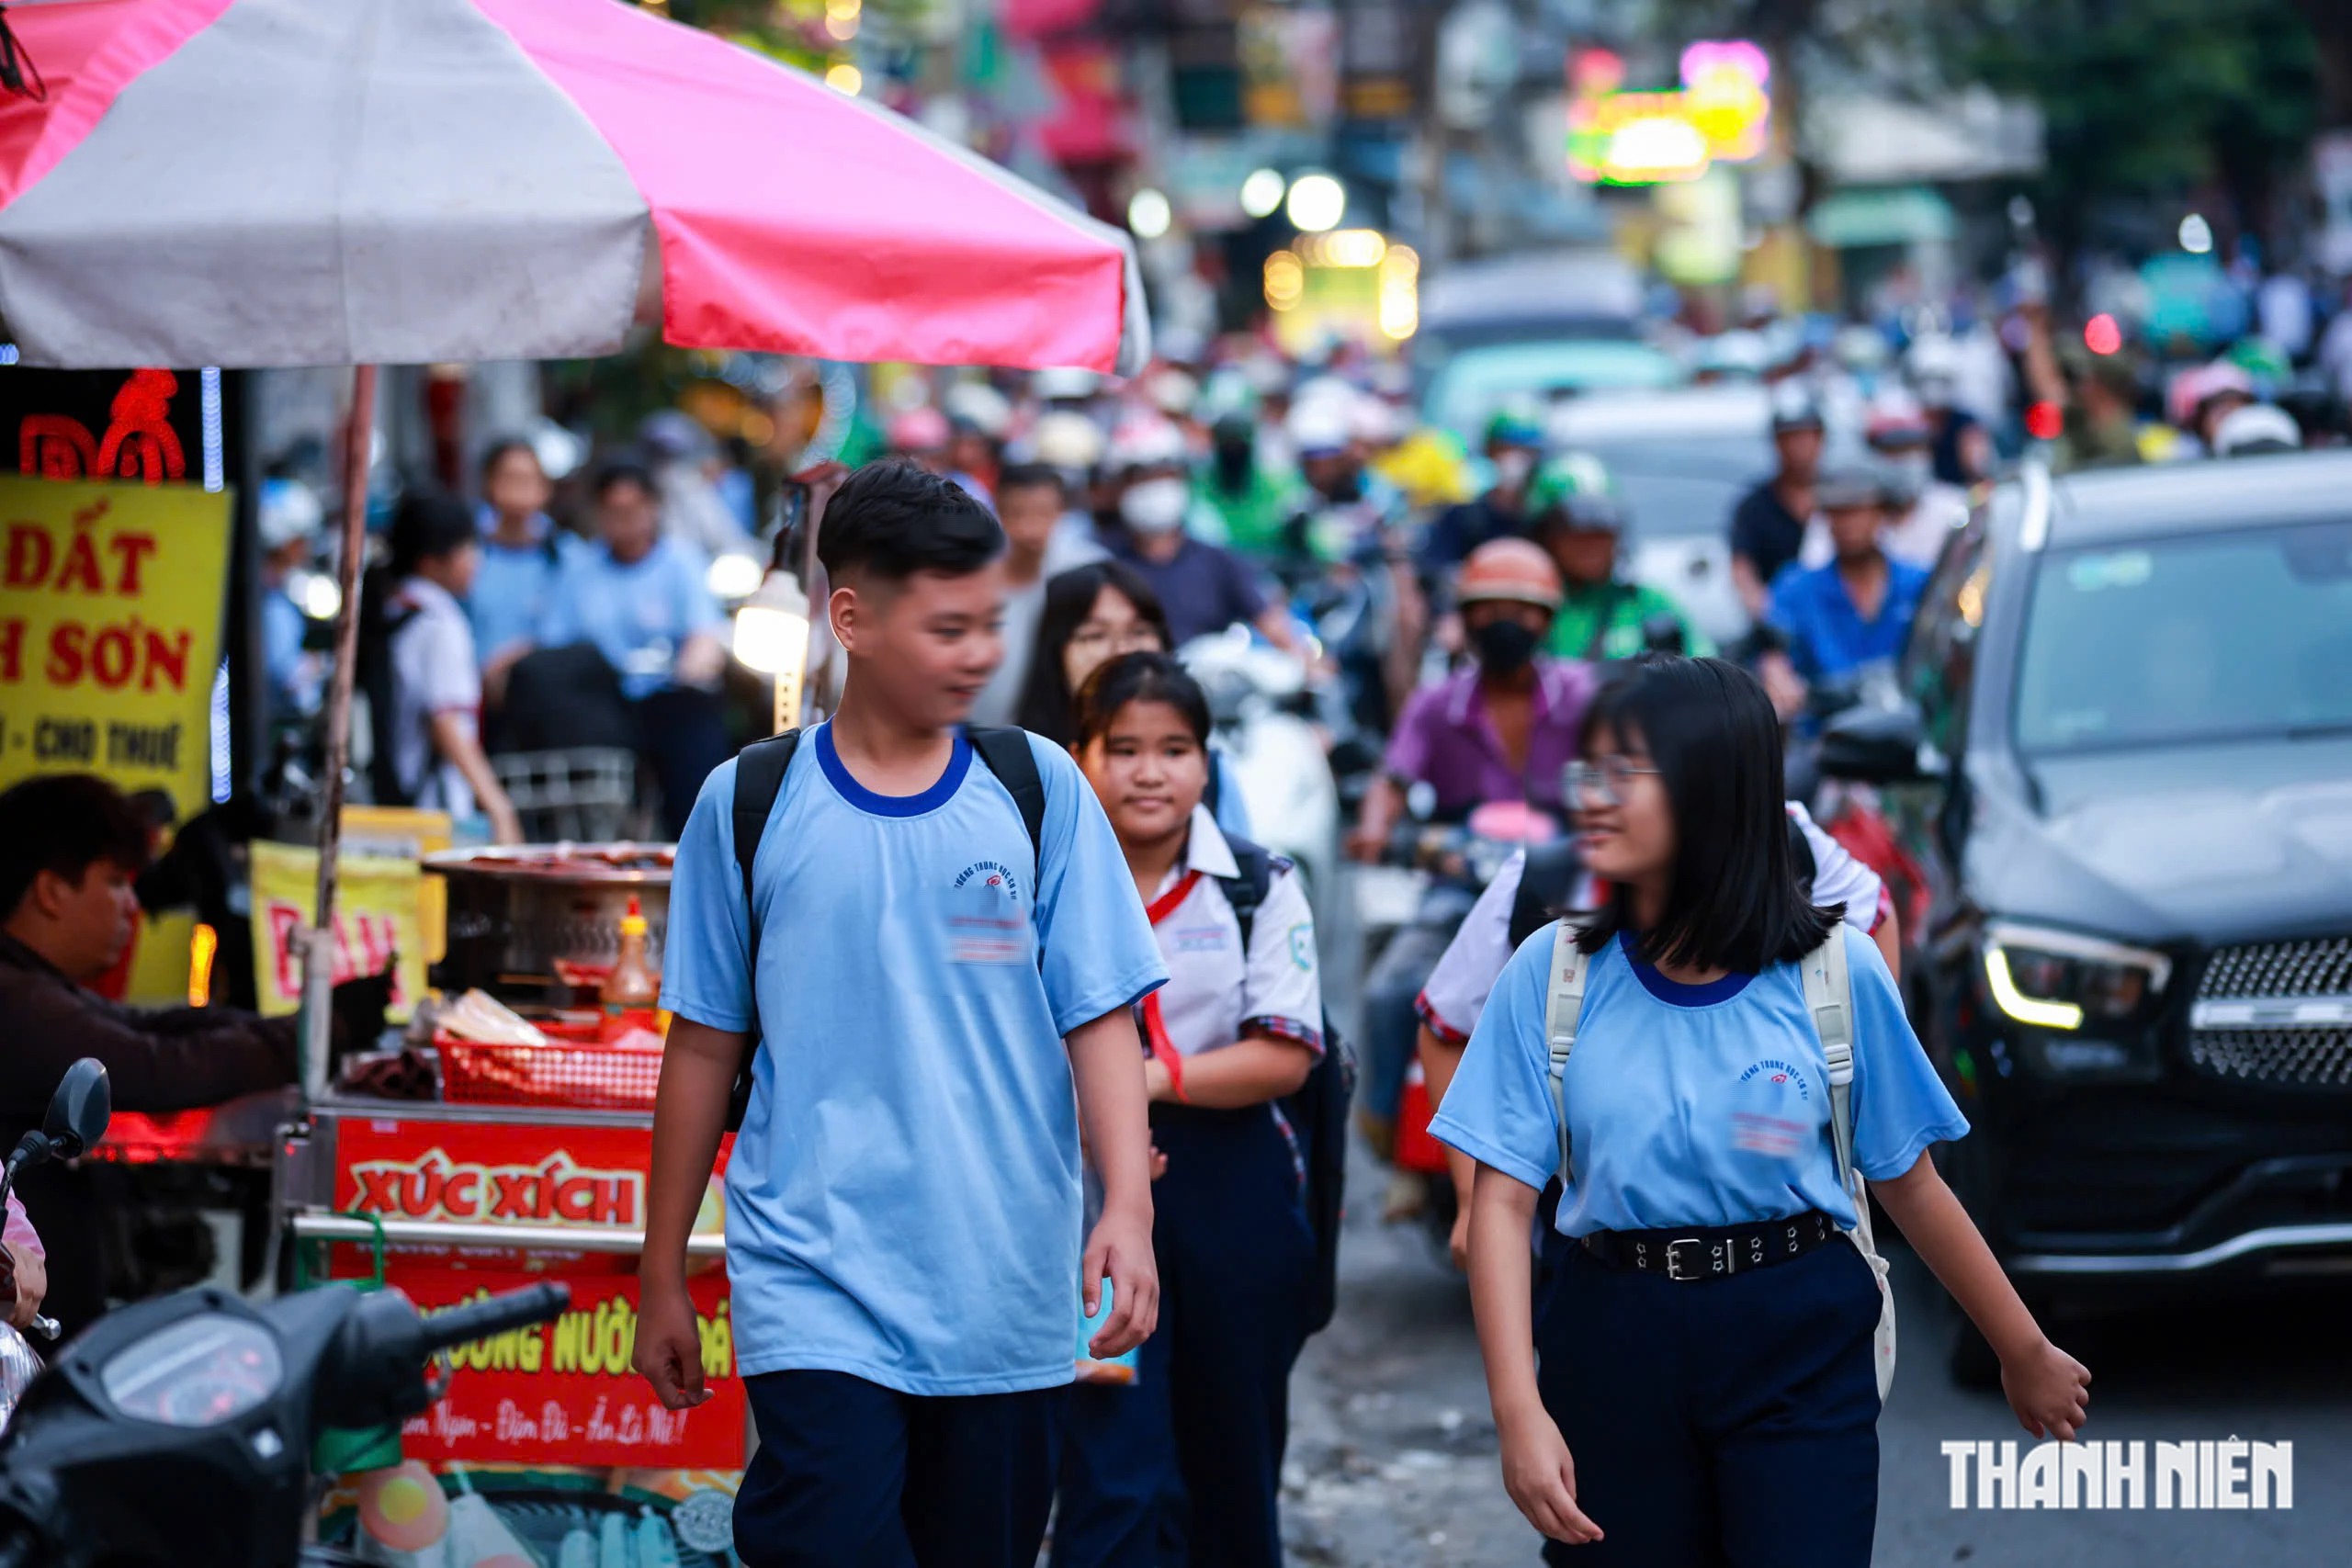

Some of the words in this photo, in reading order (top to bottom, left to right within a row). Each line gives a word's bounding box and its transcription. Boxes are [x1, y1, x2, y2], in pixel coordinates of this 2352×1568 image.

[46, 614, 194, 695] SƠN
[34, 716, 98, 765] CHO
[353, 1152, 482, 1218] XÚC
[487, 1156, 639, 1225] XÍCH
